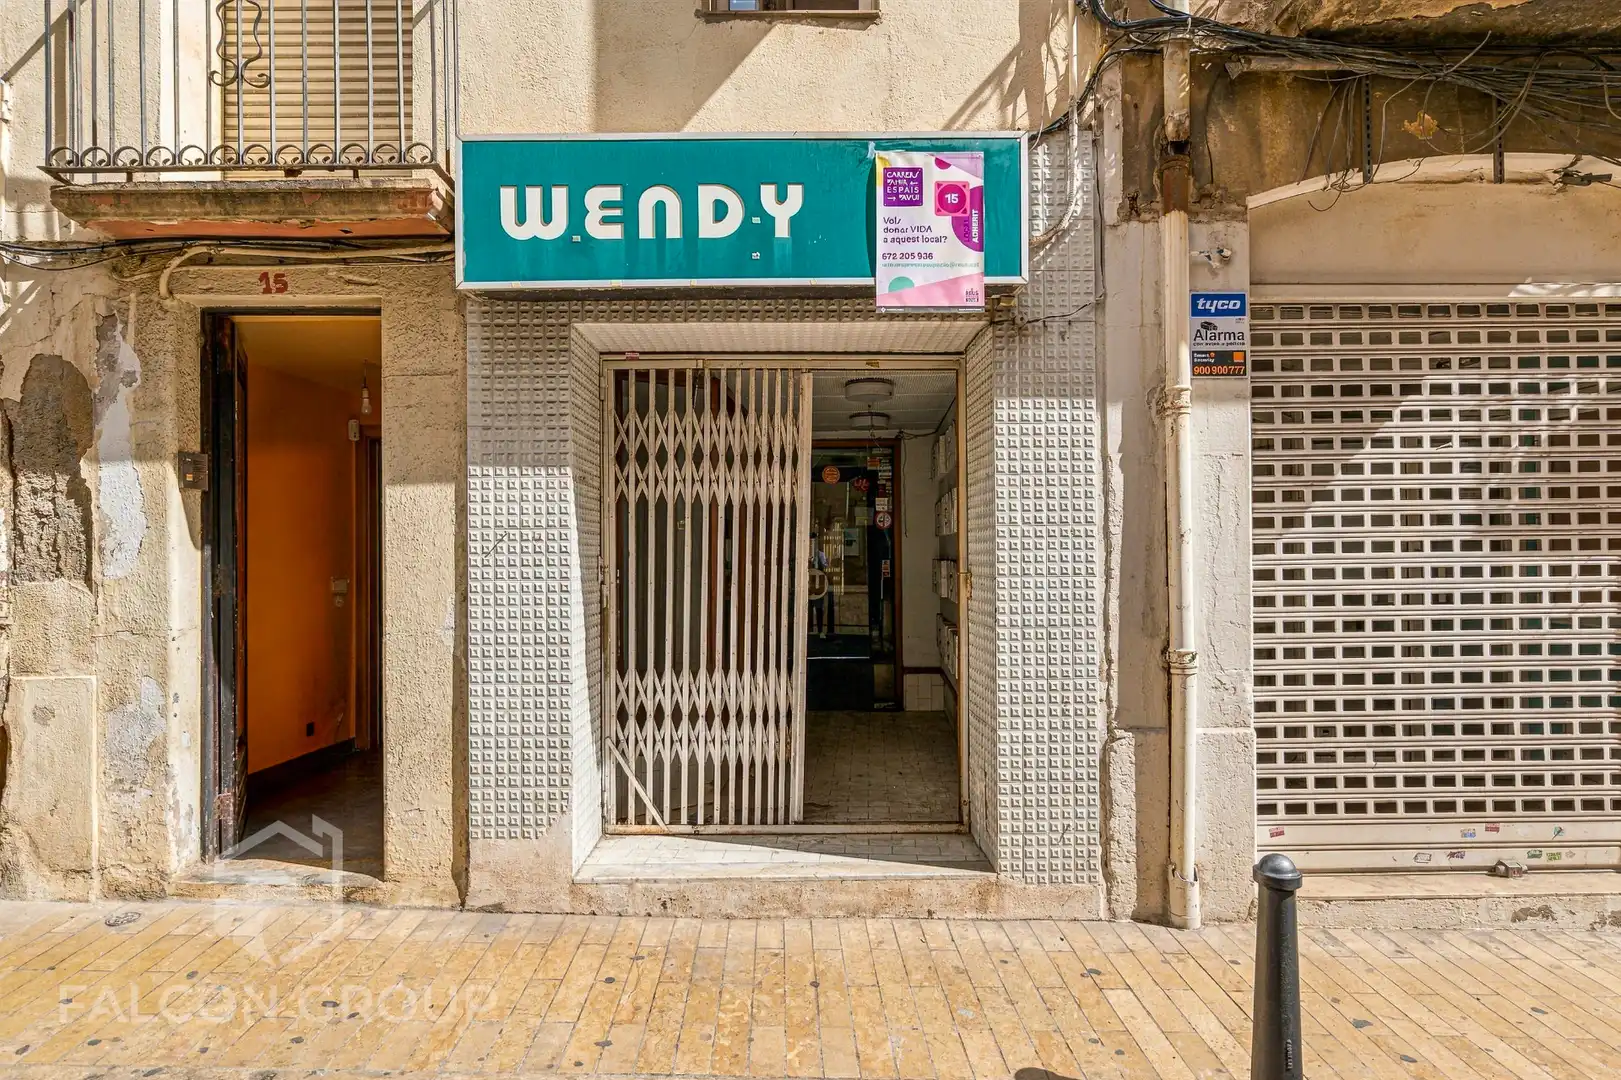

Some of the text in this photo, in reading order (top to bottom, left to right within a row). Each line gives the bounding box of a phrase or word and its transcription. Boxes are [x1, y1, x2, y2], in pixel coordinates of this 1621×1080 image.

[945, 193, 959, 204] 15
[500, 183, 804, 241] WENDY
[890, 236, 920, 244] aquest
[922, 235, 948, 243] local?
[258, 272, 288, 295] 15
[1197, 298, 1240, 313] tyco
[1194, 329, 1244, 341] Alarma
